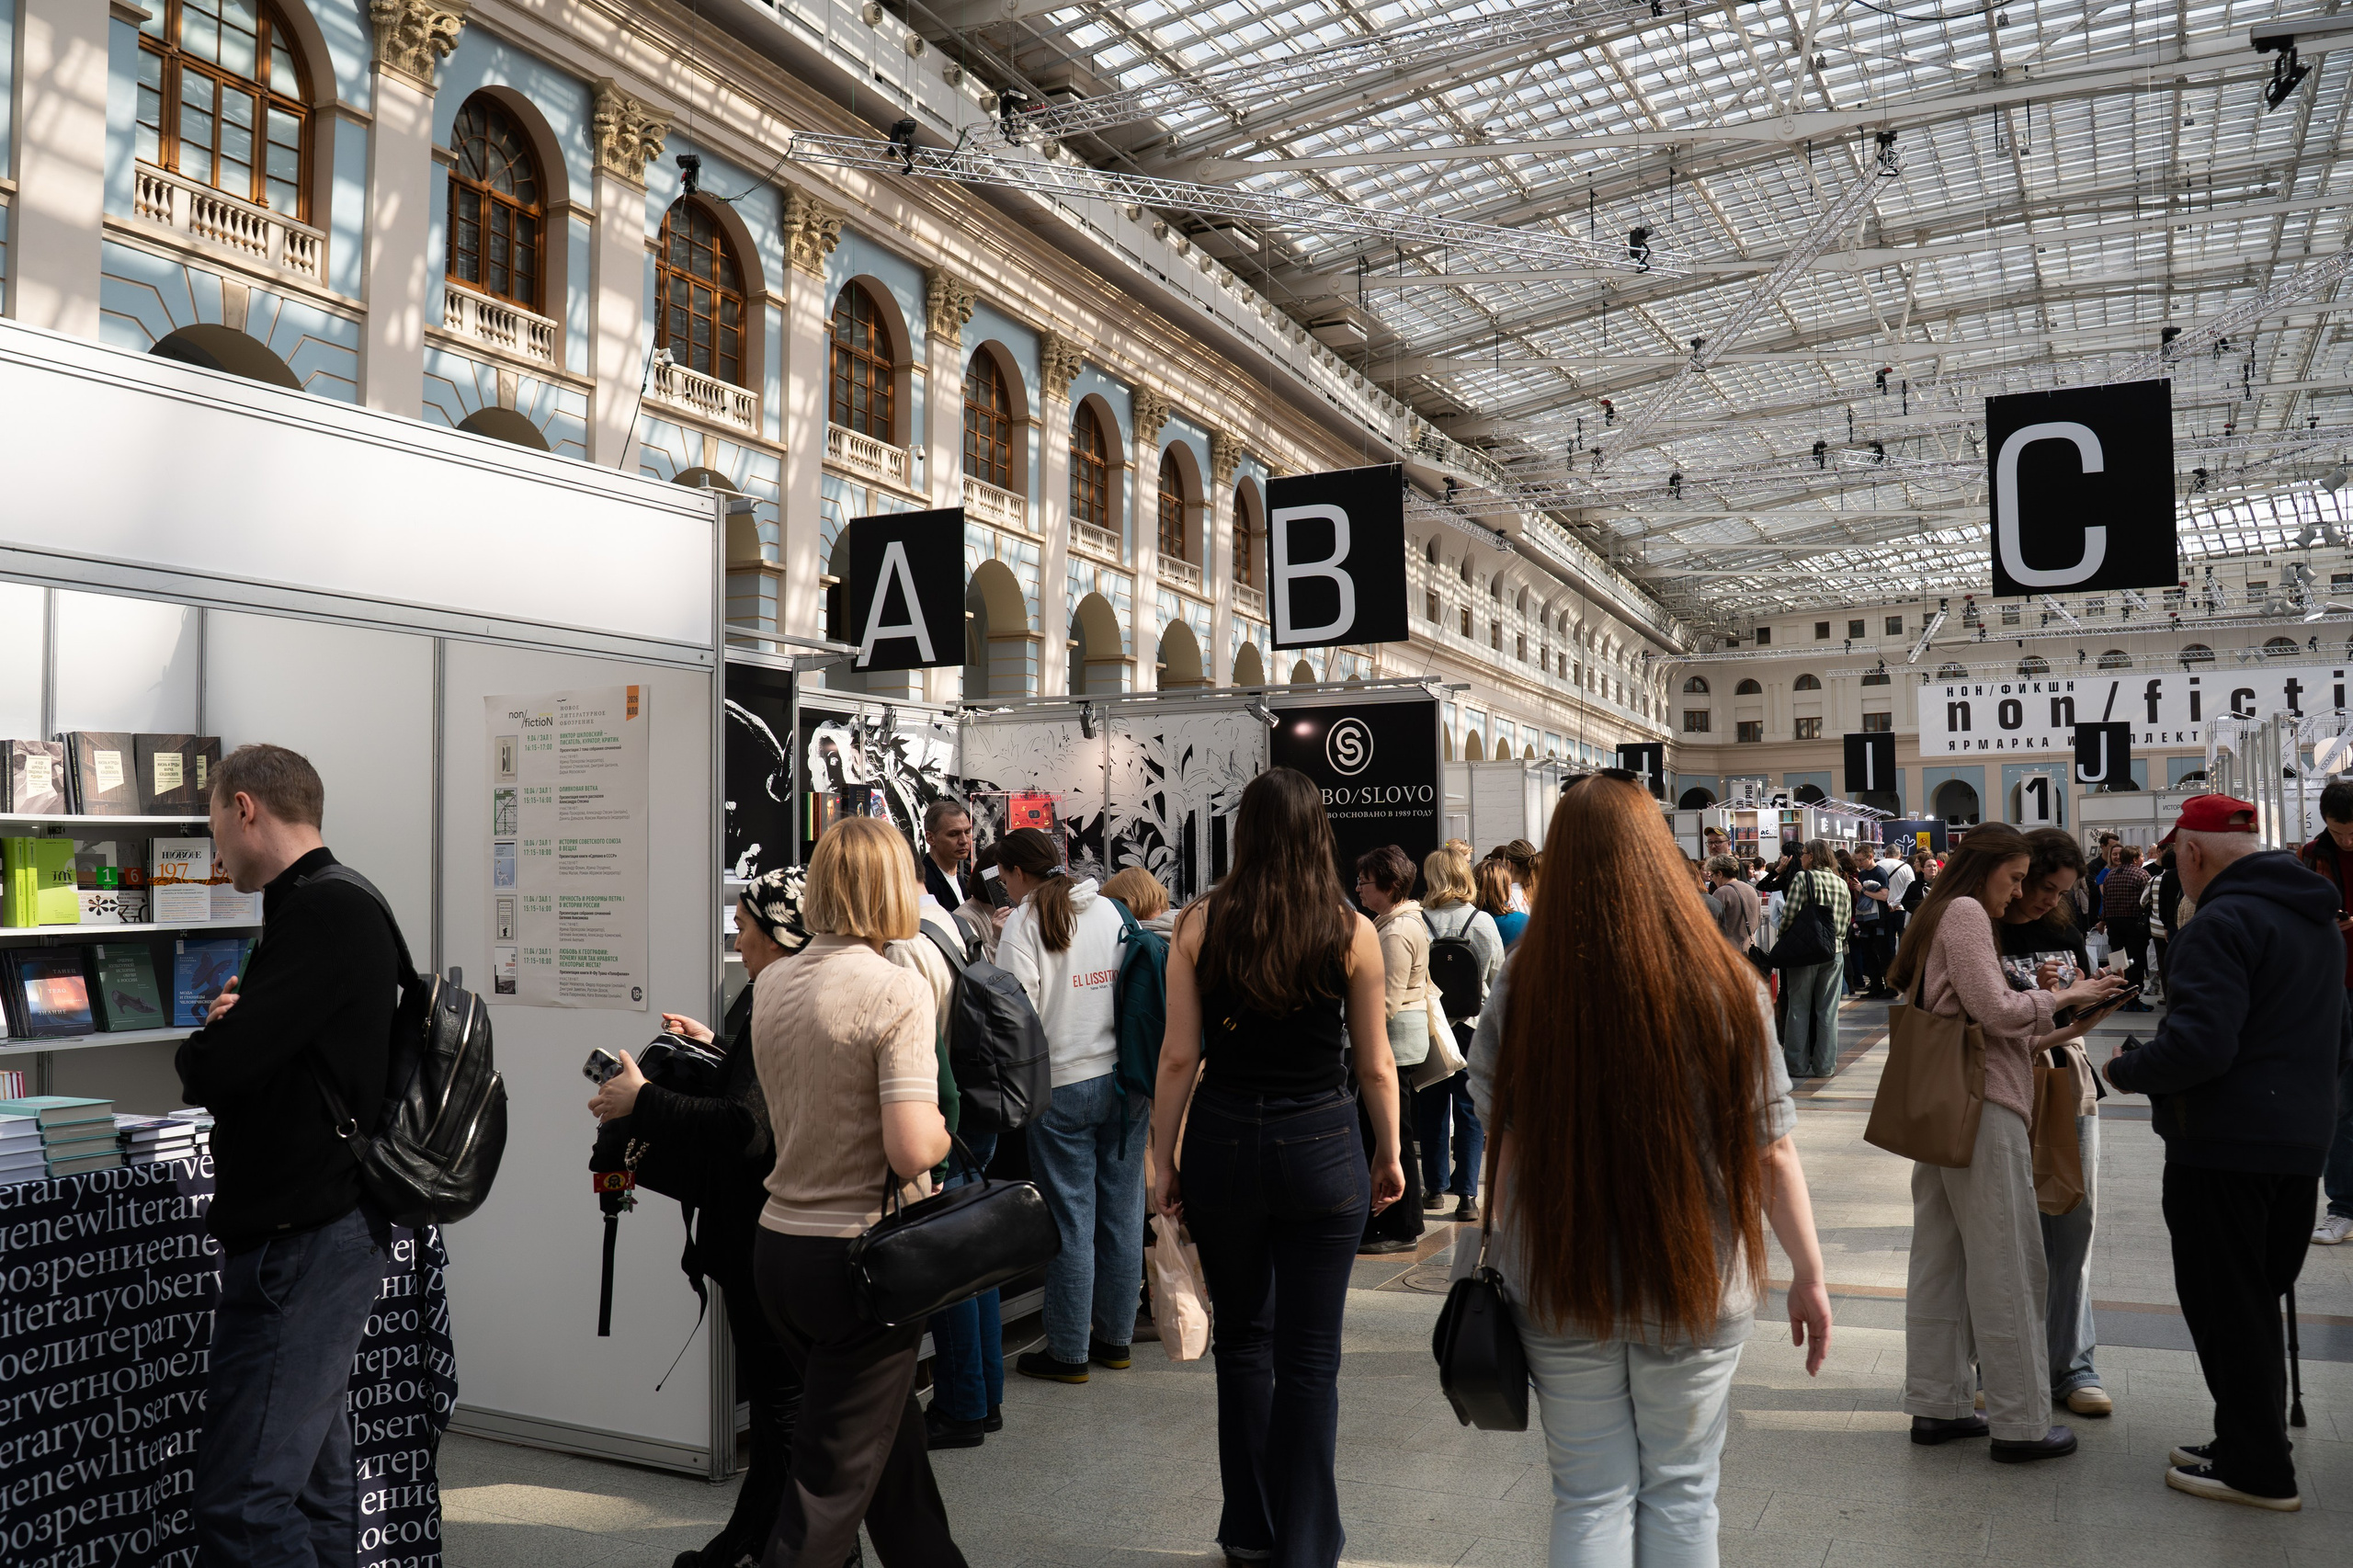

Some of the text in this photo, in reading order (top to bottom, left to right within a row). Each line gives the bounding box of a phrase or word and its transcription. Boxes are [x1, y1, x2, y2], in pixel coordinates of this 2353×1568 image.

[1996, 421, 2107, 587] C
[1271, 504, 1355, 644] B
[856, 540, 936, 667] A
[1947, 680, 2075, 697] НОН/ФИКШН
[1948, 736, 2050, 751] ЯРМАРКА
[2076, 731, 2107, 782] J
[2025, 777, 2049, 820] 1
[1339, 811, 1387, 819] ОСНОВАНО
[1395, 810, 1412, 818] 1989
[1413, 809, 1434, 818] ГОДУ
[2163, 803, 2183, 812] ИСТОР
[104, 868, 111, 882] 1
[131, 869, 139, 883] 6
[157, 862, 188, 880] 197
[1073, 974, 1084, 988] EL
[0, 1310, 215, 1381] оелитерату
